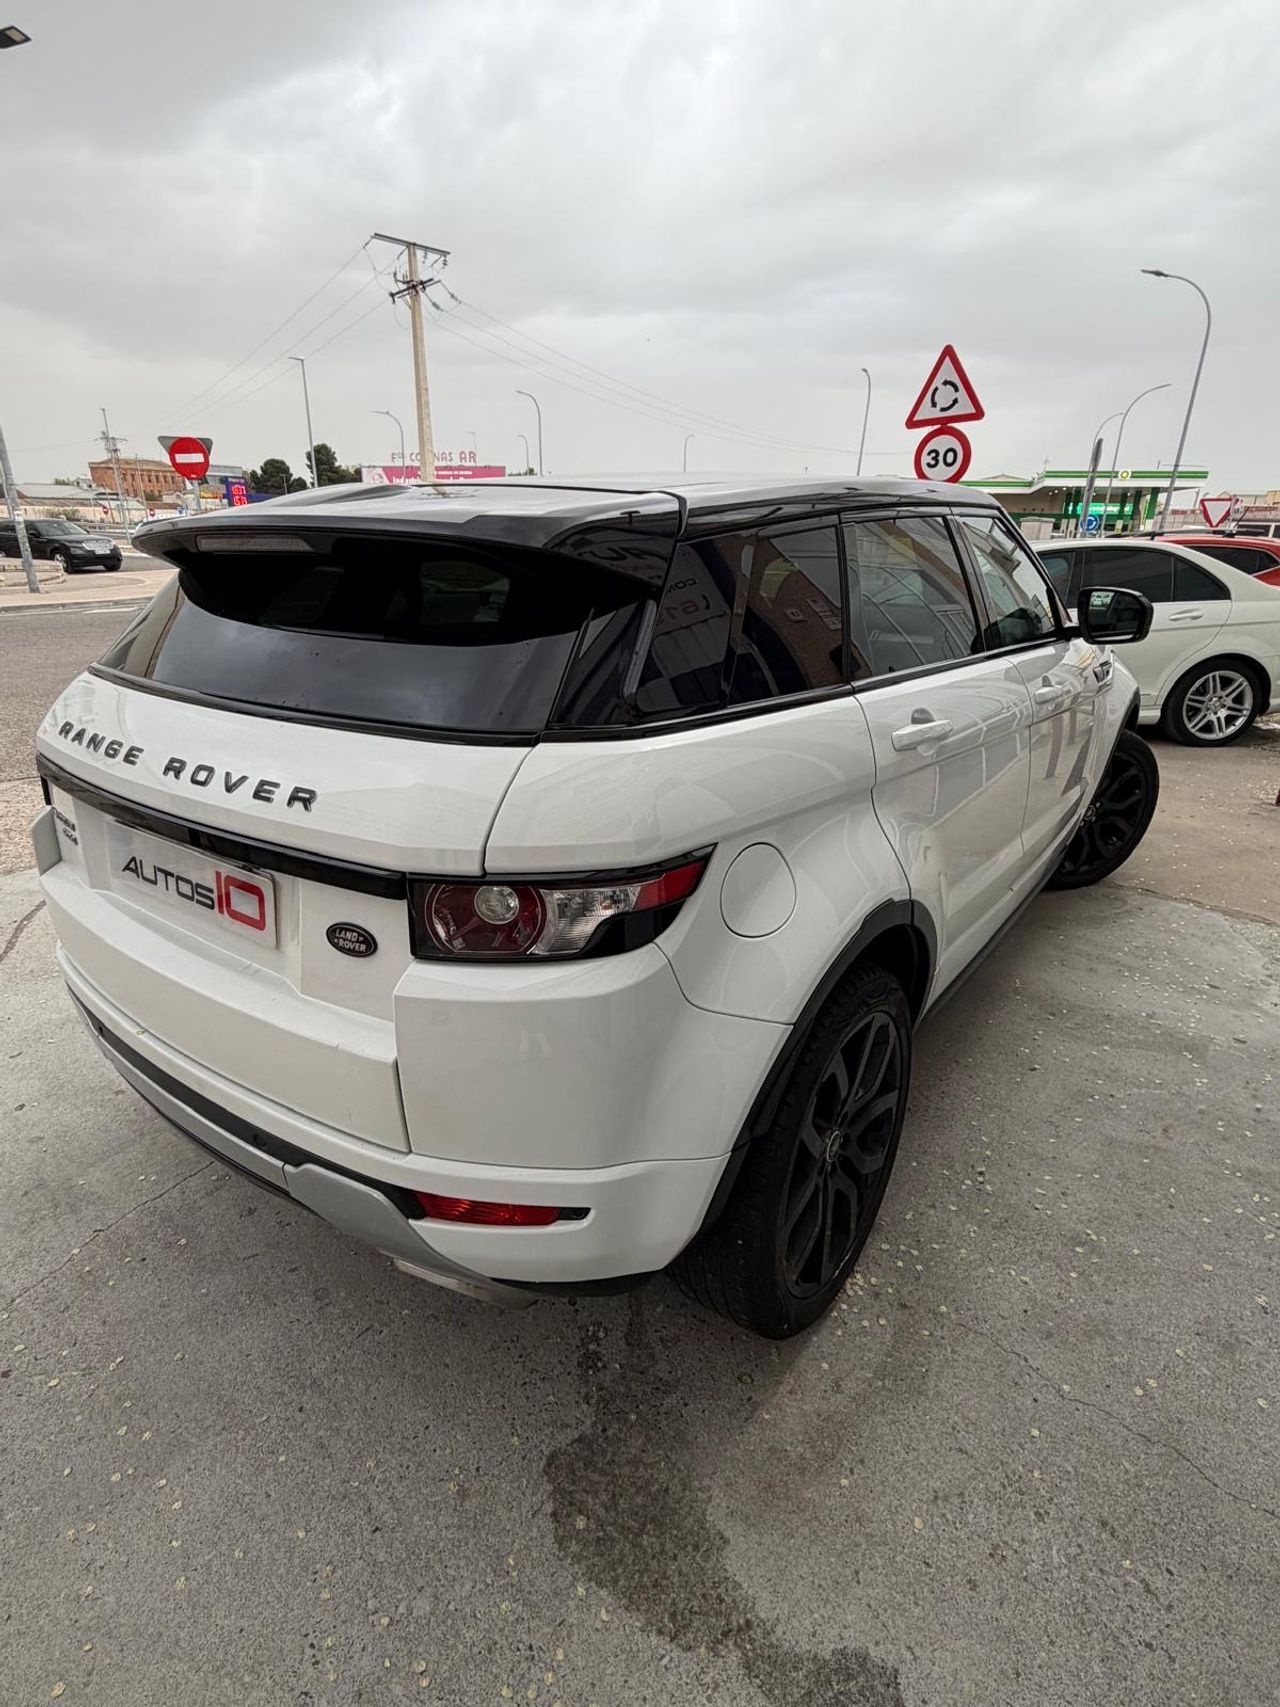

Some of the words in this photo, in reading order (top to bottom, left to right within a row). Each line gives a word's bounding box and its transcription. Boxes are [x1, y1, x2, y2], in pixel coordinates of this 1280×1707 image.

[459, 450, 477, 464] AR
[925, 447, 958, 469] 30
[58, 721, 144, 766] RANGE
[162, 756, 318, 813] ROVER
[335, 928, 358, 942] LAND
[338, 938, 367, 952] ROVER
